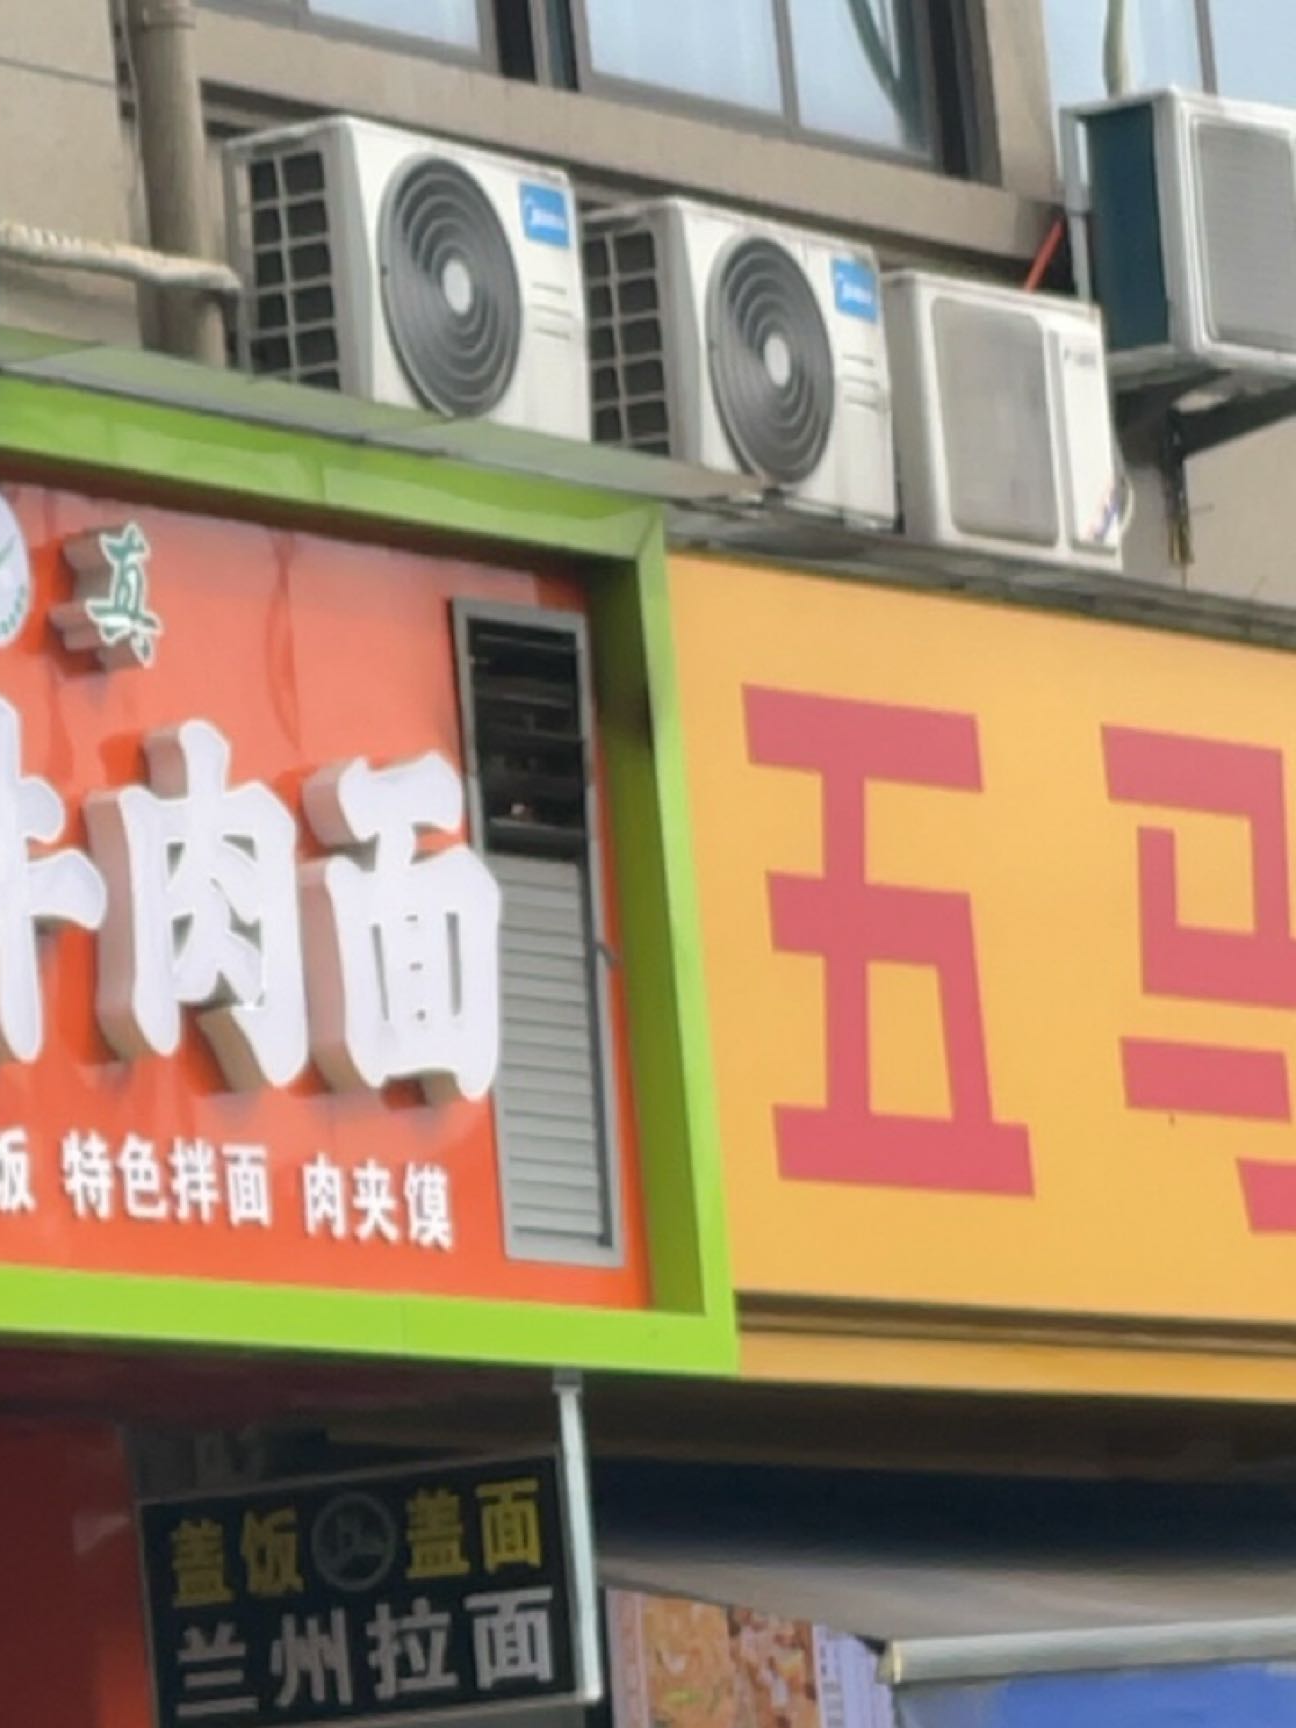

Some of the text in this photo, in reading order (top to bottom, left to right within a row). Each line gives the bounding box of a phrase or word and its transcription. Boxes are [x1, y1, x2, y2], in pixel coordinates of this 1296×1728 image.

[86, 522, 162, 668] 真
[61, 1128, 272, 1228] 特色拌面
[301, 1151, 455, 1252] 肉夹馍
[170, 1477, 543, 1608] 盖饭 盖面
[176, 1585, 555, 1718] 兰州拉面
